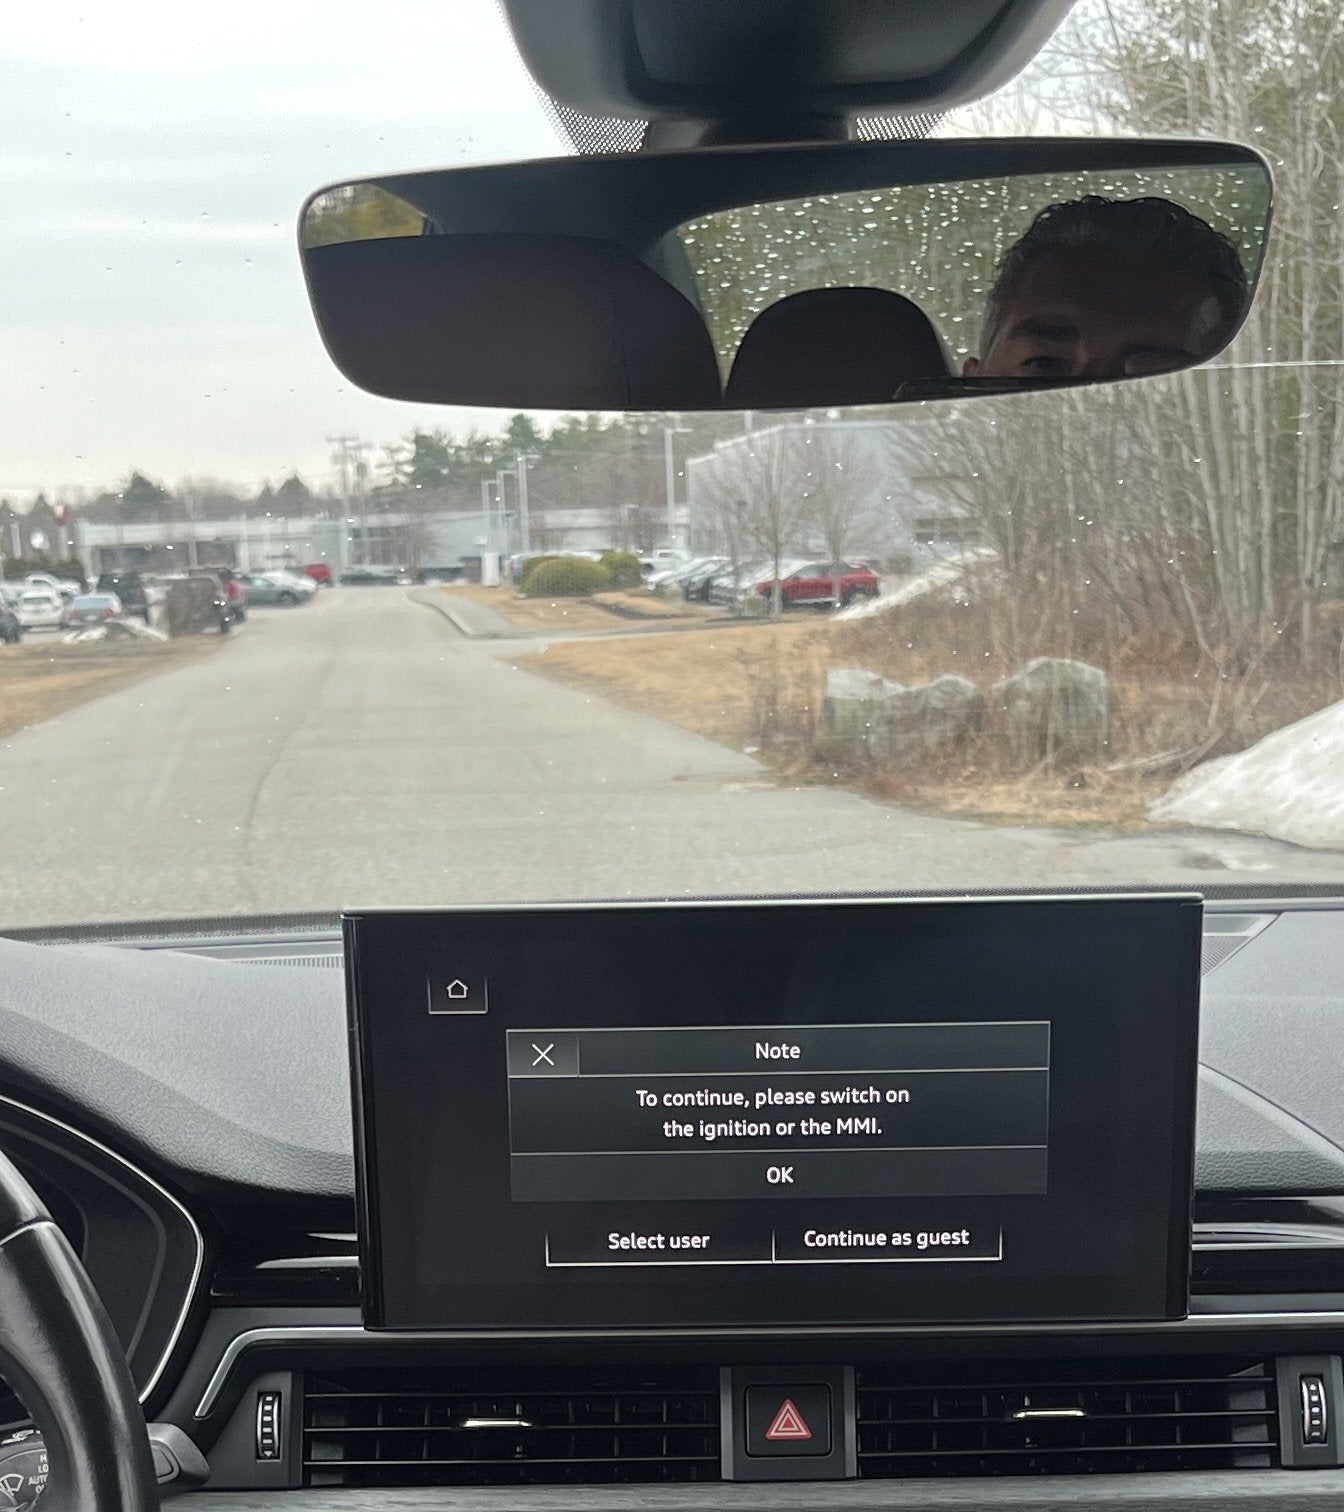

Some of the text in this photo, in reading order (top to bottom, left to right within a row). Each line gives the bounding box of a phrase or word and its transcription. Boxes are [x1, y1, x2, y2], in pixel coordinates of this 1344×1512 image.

[755, 1042, 801, 1060] Note
[635, 1085, 910, 1110] To continue, please switch on
[662, 1117, 883, 1141] the ignition or the MMI.
[766, 1166, 794, 1184] OK
[608, 1232, 711, 1250] Select user
[804, 1229, 970, 1250] Continue as guest
